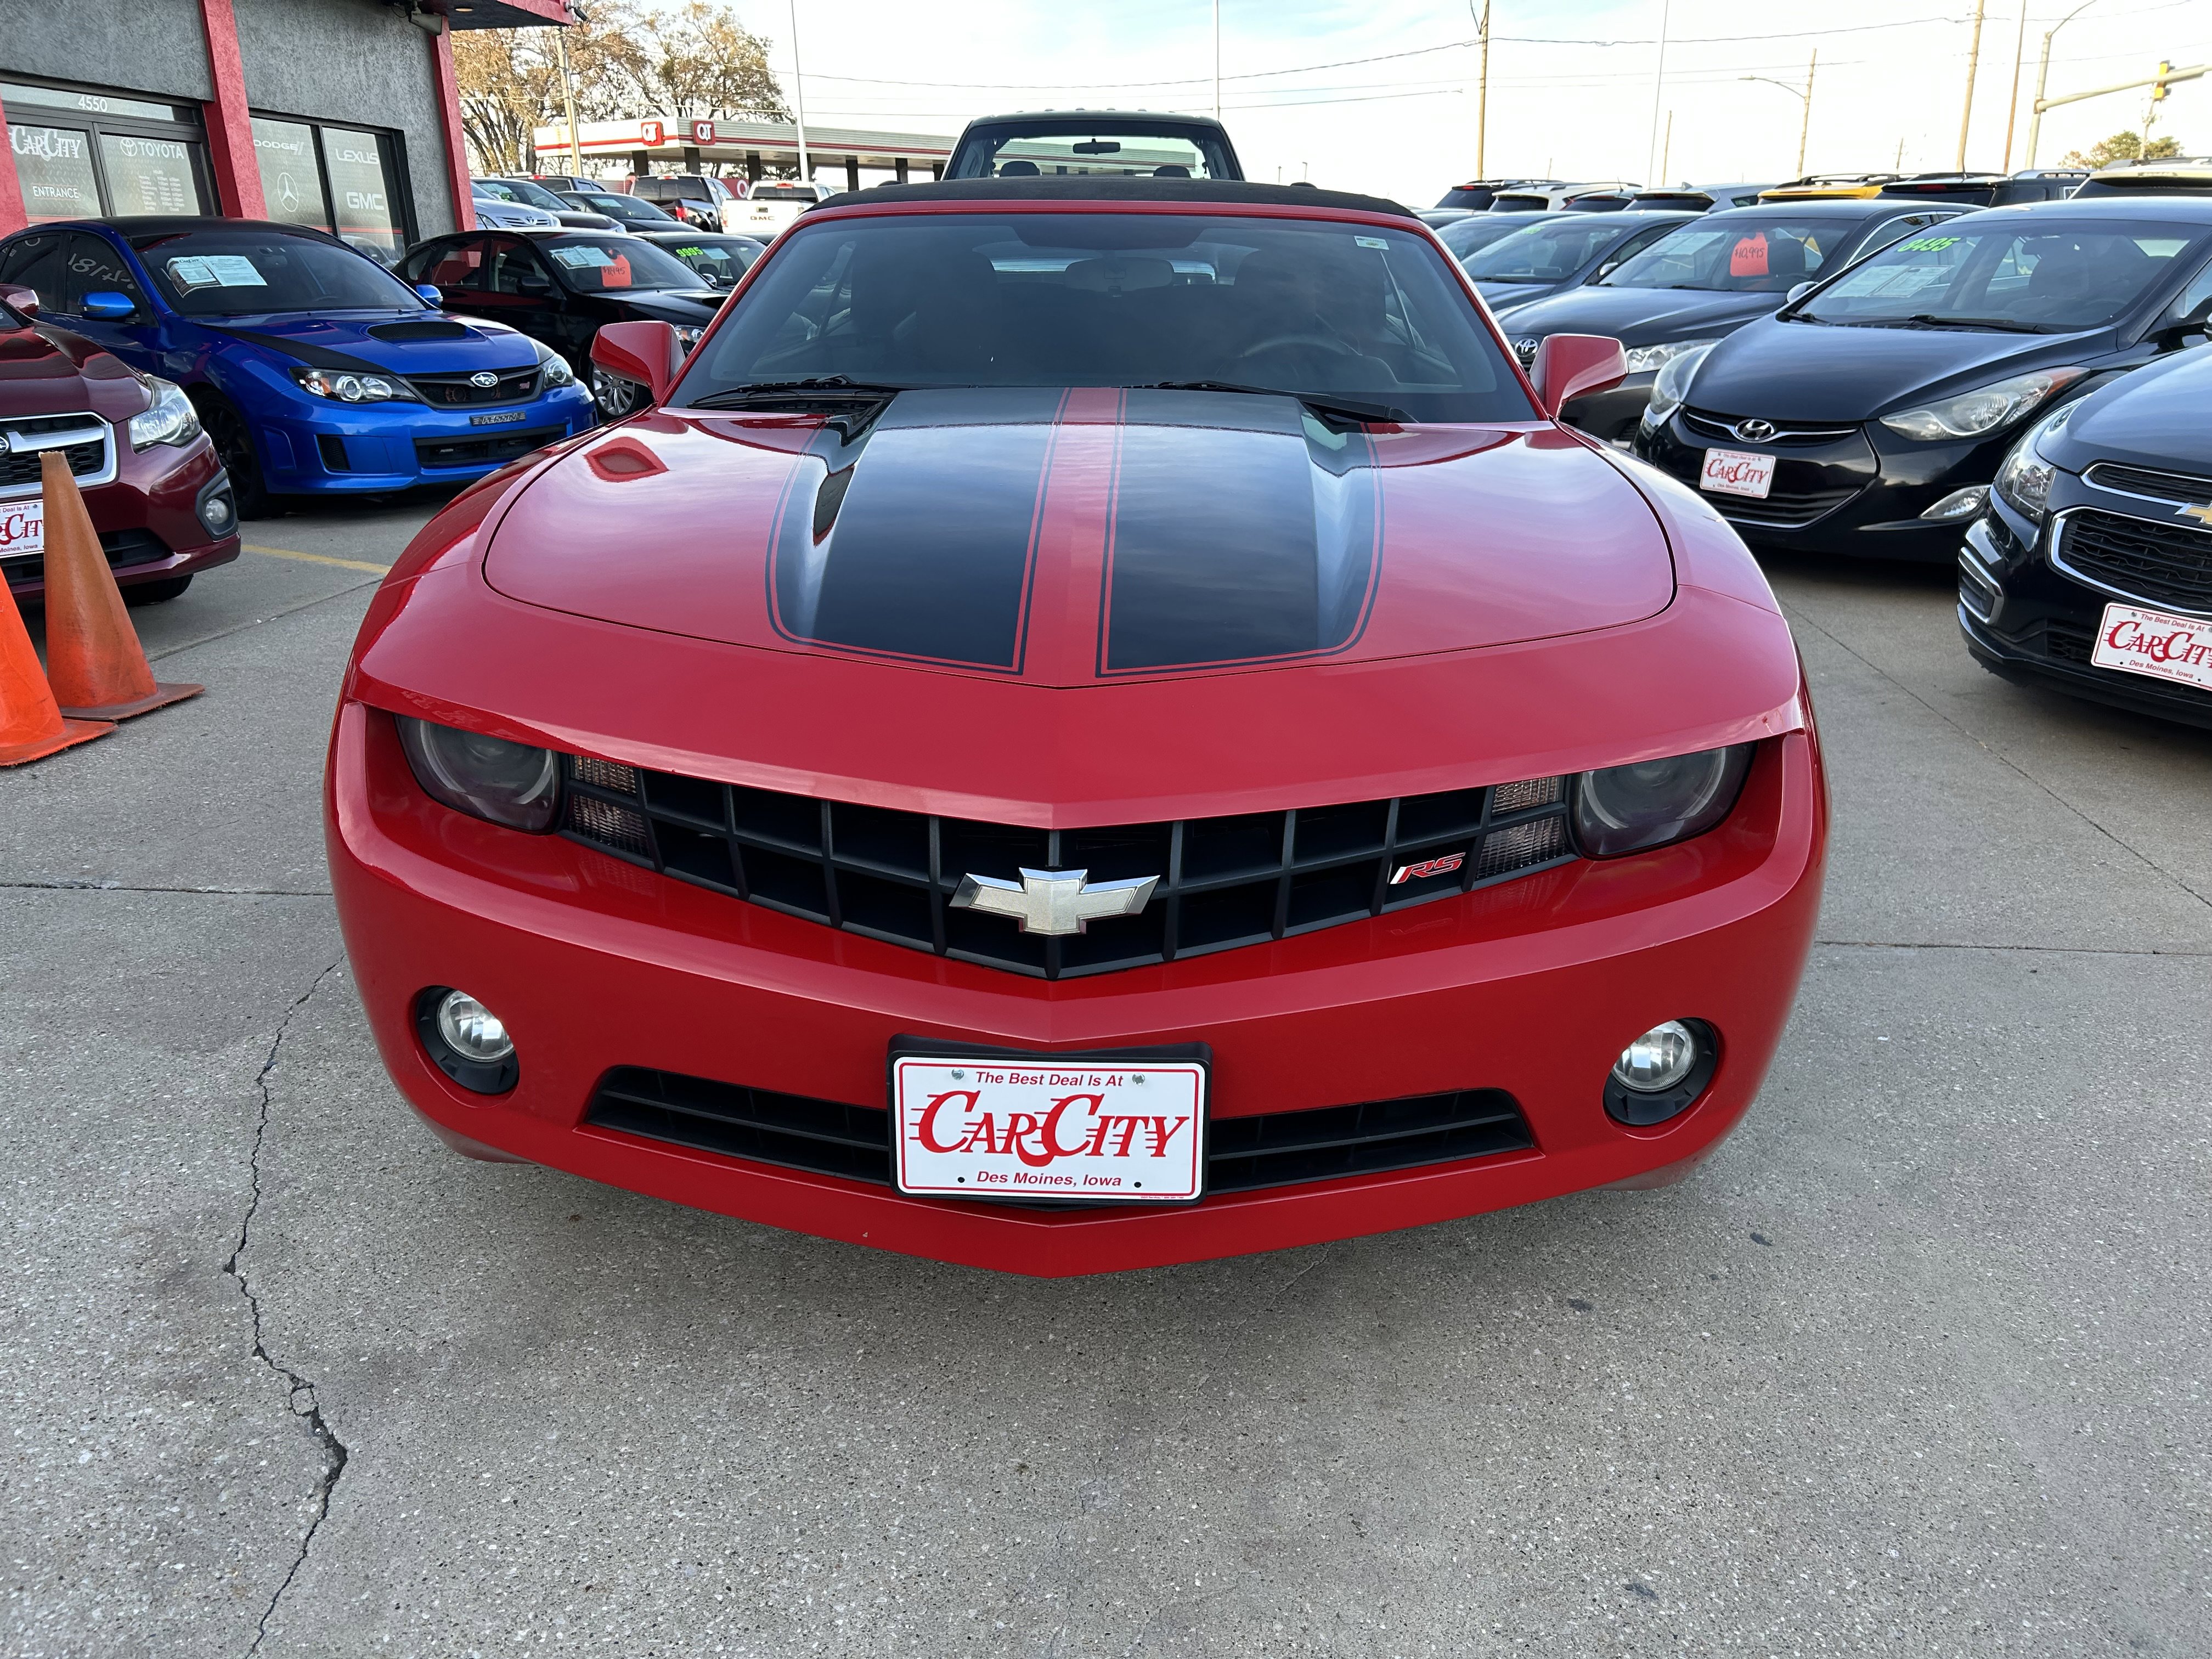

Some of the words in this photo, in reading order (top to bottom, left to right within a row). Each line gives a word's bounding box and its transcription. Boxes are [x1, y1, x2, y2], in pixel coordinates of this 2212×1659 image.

[78, 95, 108, 112] 4550
[642, 123, 657, 143] QT
[697, 123, 712, 141] QT
[138, 142, 184, 160] TOYOTA
[253, 139, 299, 151] DODGE
[335, 149, 380, 165] LEXUS
[32, 185, 80, 199] ENTRANCE
[347, 191, 385, 211] GMC
[676, 247, 704, 257] 9995
[1735, 246, 1765, 259] $10,995
[1897, 237, 1961, 252] 8495
[482, 413, 518, 425] PERRIN
[2154, 617, 2171, 625] Best
[2171, 620, 2188, 628] Deal
[2145, 663, 2174, 675] Moines,
[2176, 670, 2194, 679] Iowa
[1390, 852, 1466, 884] RS
[975, 1071, 1004, 1084] The
[1008, 1073, 1045, 1085] Best
[1048, 1074, 1084, 1086] Deal
[1087, 1074, 1102, 1086] Is
[1104, 1075, 1124, 1087] At
[977, 1171, 1008, 1183] Des
[1013, 1172, 1077, 1188] Moines,
[1082, 1174, 1122, 1187] Iowa
